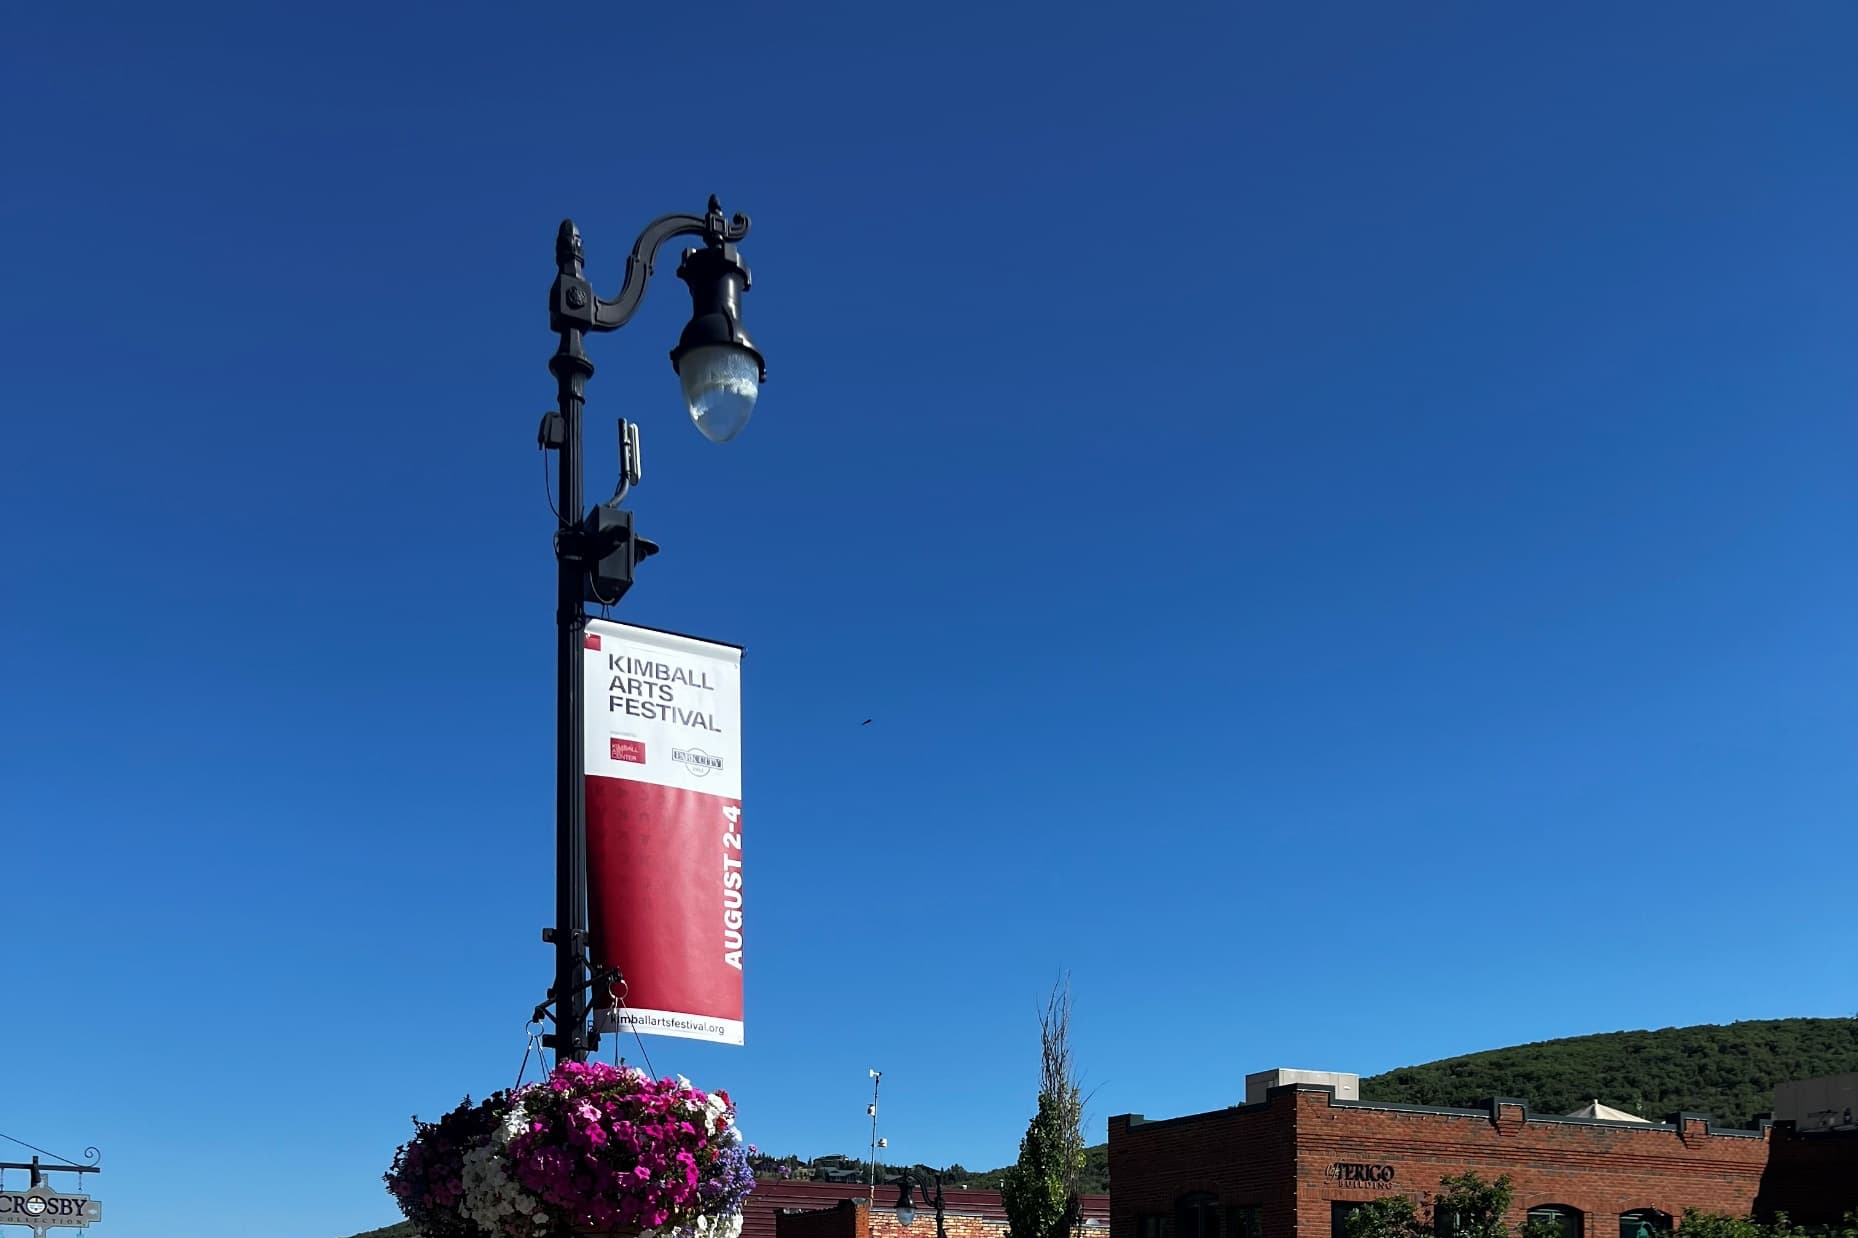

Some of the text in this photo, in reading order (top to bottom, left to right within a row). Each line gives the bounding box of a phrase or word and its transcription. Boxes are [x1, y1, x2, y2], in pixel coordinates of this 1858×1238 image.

[608, 653, 714, 691] KIMBALL
[608, 674, 674, 702] ARTS
[609, 695, 722, 733] FESTIVAL
[722, 805, 743, 970] AUGUST 2-4
[1334, 1162, 1395, 1182] TERIGO
[1338, 1180, 1393, 1190] BUILDING
[0, 1195, 88, 1217] CROSBY
